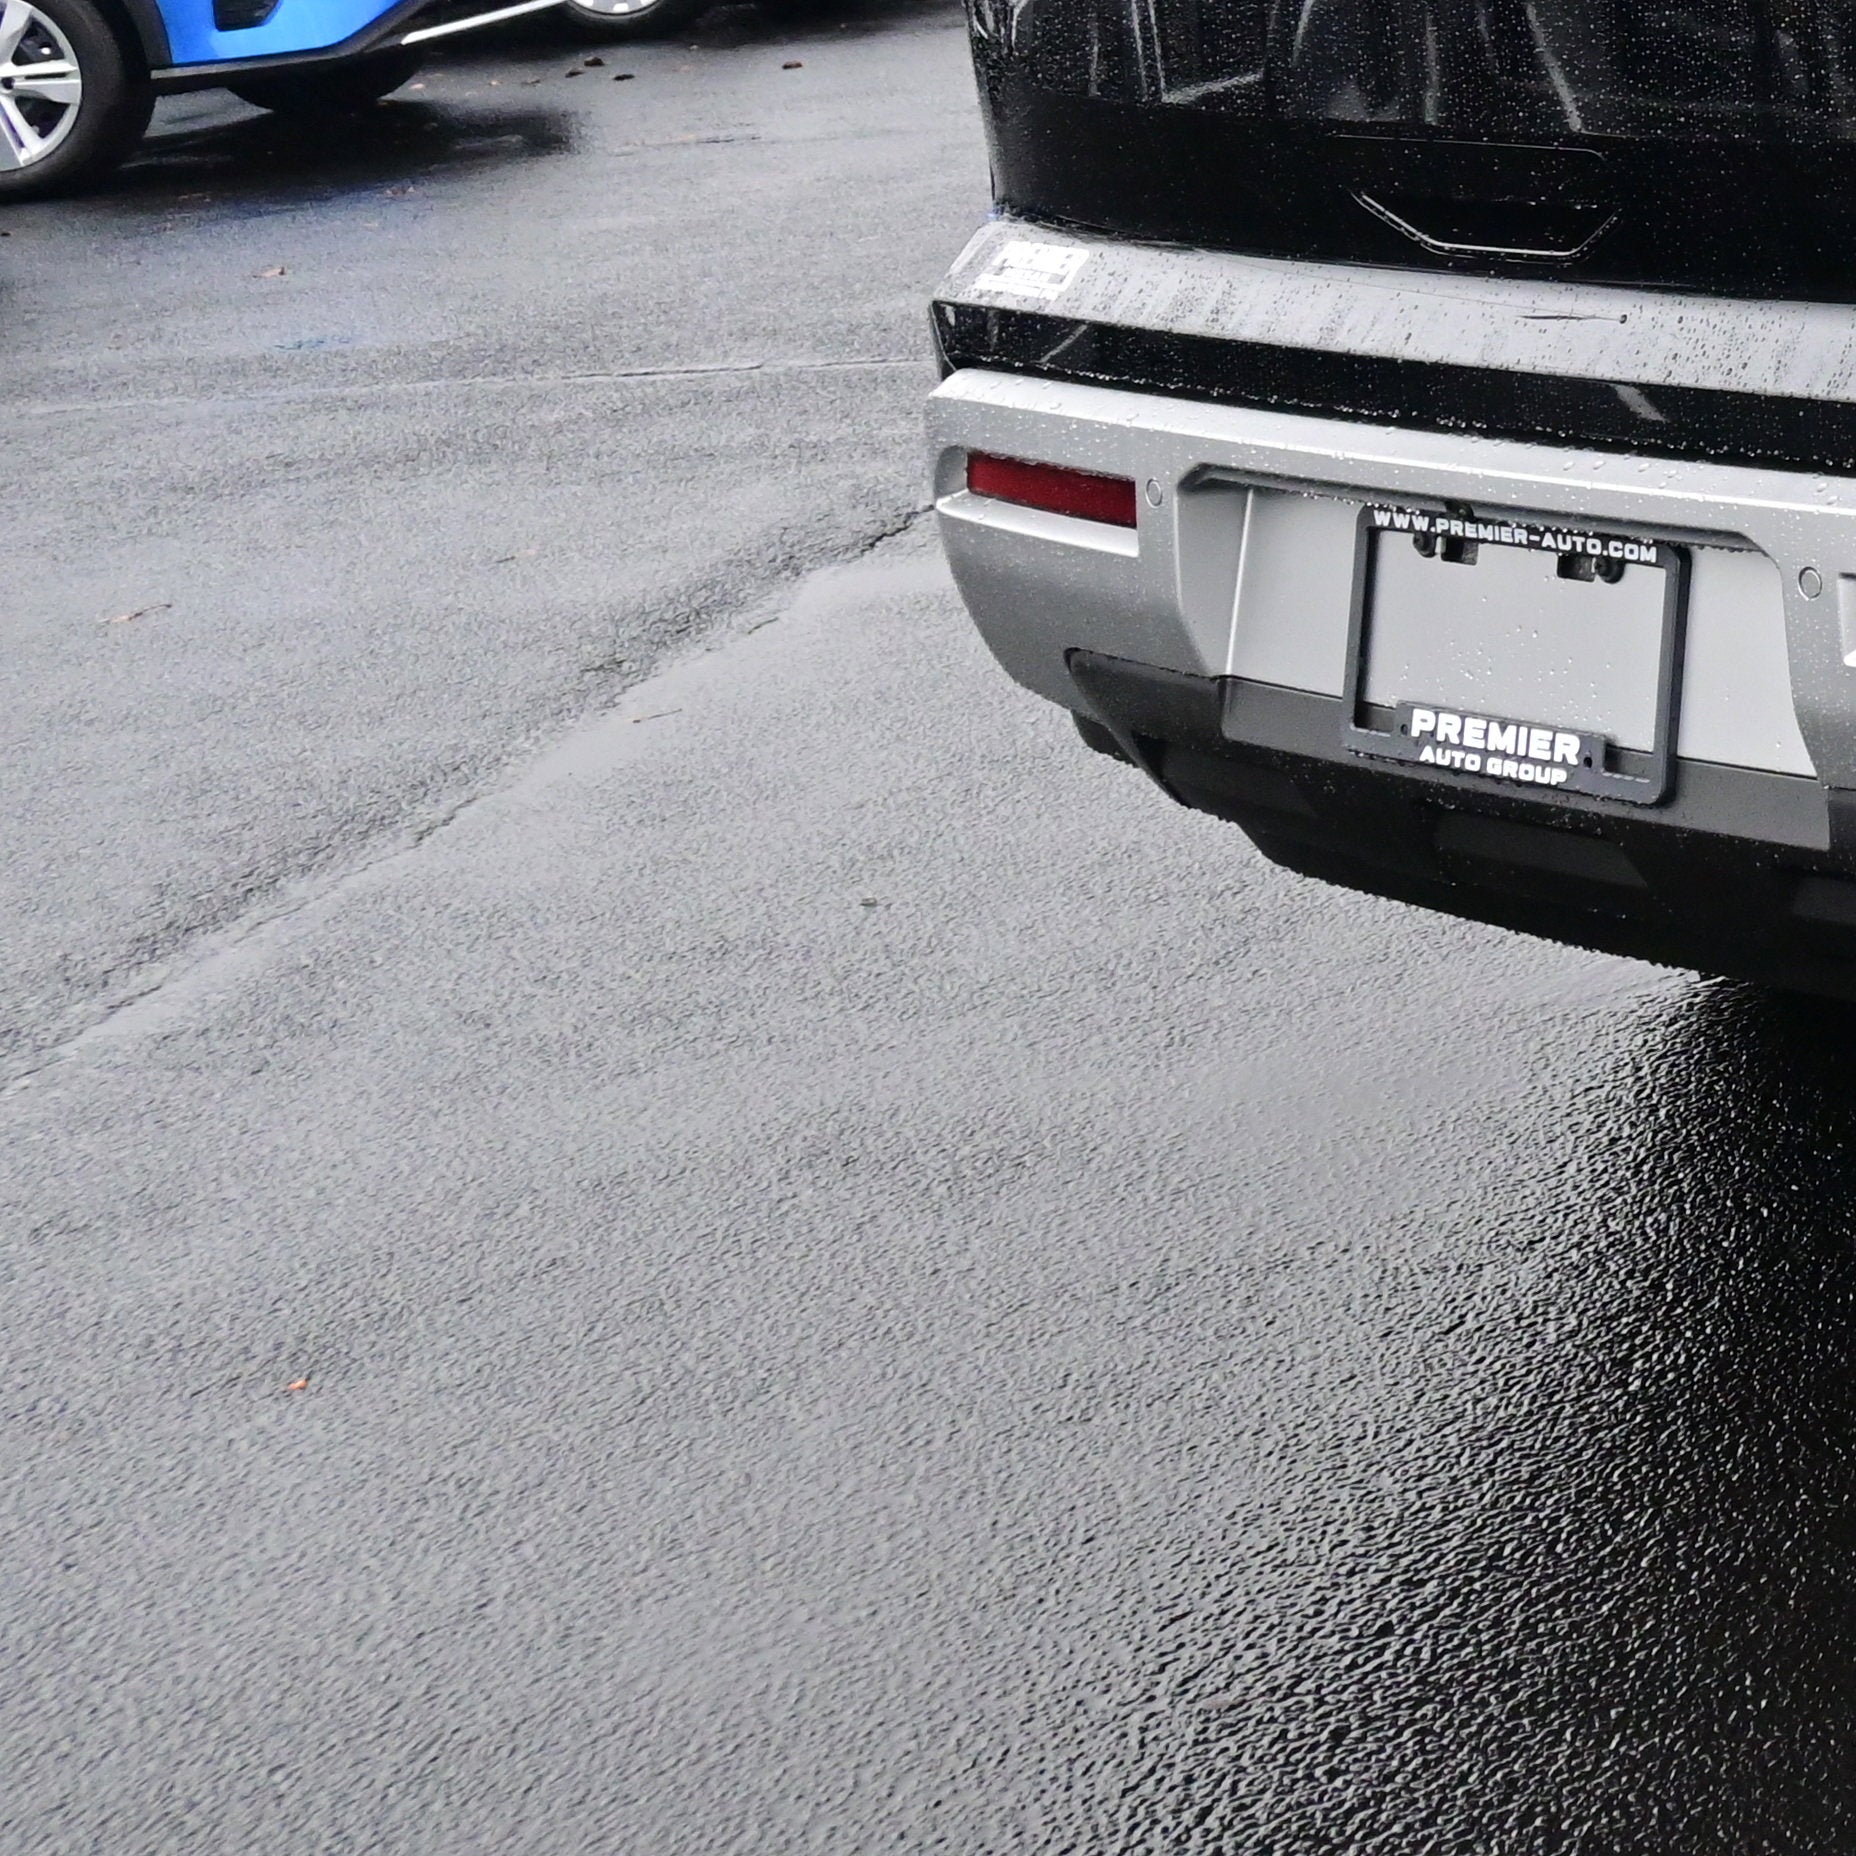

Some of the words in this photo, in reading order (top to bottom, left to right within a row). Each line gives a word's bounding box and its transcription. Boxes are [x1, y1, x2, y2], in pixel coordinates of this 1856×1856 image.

[1373, 509, 1657, 564] WWW.PREMIER-AUTO.COM
[1410, 708, 1581, 766] PREMIER
[1419, 745, 1481, 772] AUTO
[1486, 756, 1568, 786] GROUP
